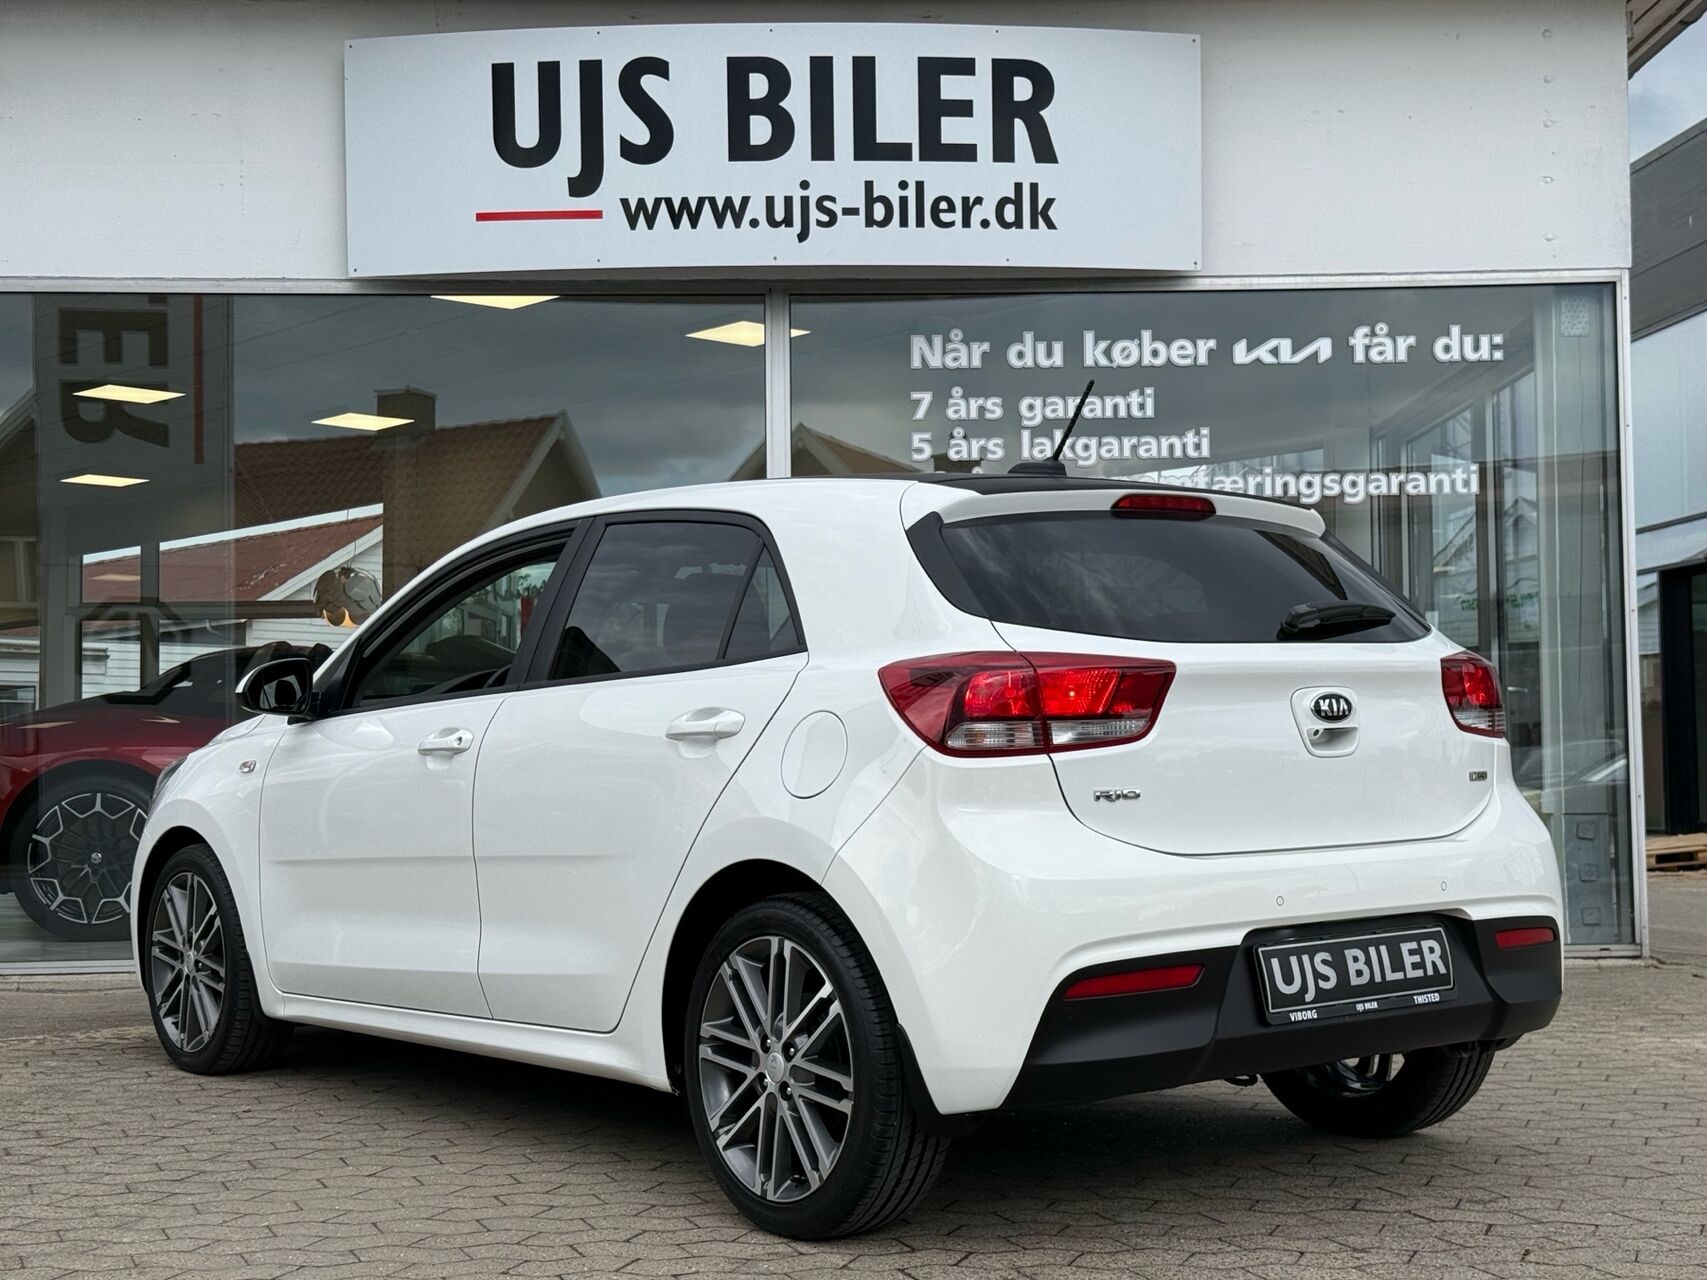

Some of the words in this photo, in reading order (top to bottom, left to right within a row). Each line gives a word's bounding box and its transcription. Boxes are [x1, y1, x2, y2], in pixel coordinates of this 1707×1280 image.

[491, 56, 674, 198] UJS
[726, 56, 1059, 164] BILER
[619, 180, 1058, 244] www.ujs-biler.dk
[910, 328, 990, 369] Når
[1006, 331, 1063, 368] du
[1083, 329, 1217, 368] køber
[1349, 322, 1416, 363] får
[1433, 325, 1504, 362] du:
[910, 391, 933, 421] 7
[946, 386, 1003, 420] års
[1019, 387, 1155, 427] garanti
[910, 432, 932, 461] 5
[948, 427, 1005, 461] års
[1020, 427, 1211, 467] lakgaranti
[1318, 698, 1349, 716] KIA
[1270, 951, 1338, 1003] UJS
[1343, 939, 1448, 986] BILER
[1289, 1009, 1318, 1022] VIBORG
[1413, 992, 1440, 1005] THISTED
